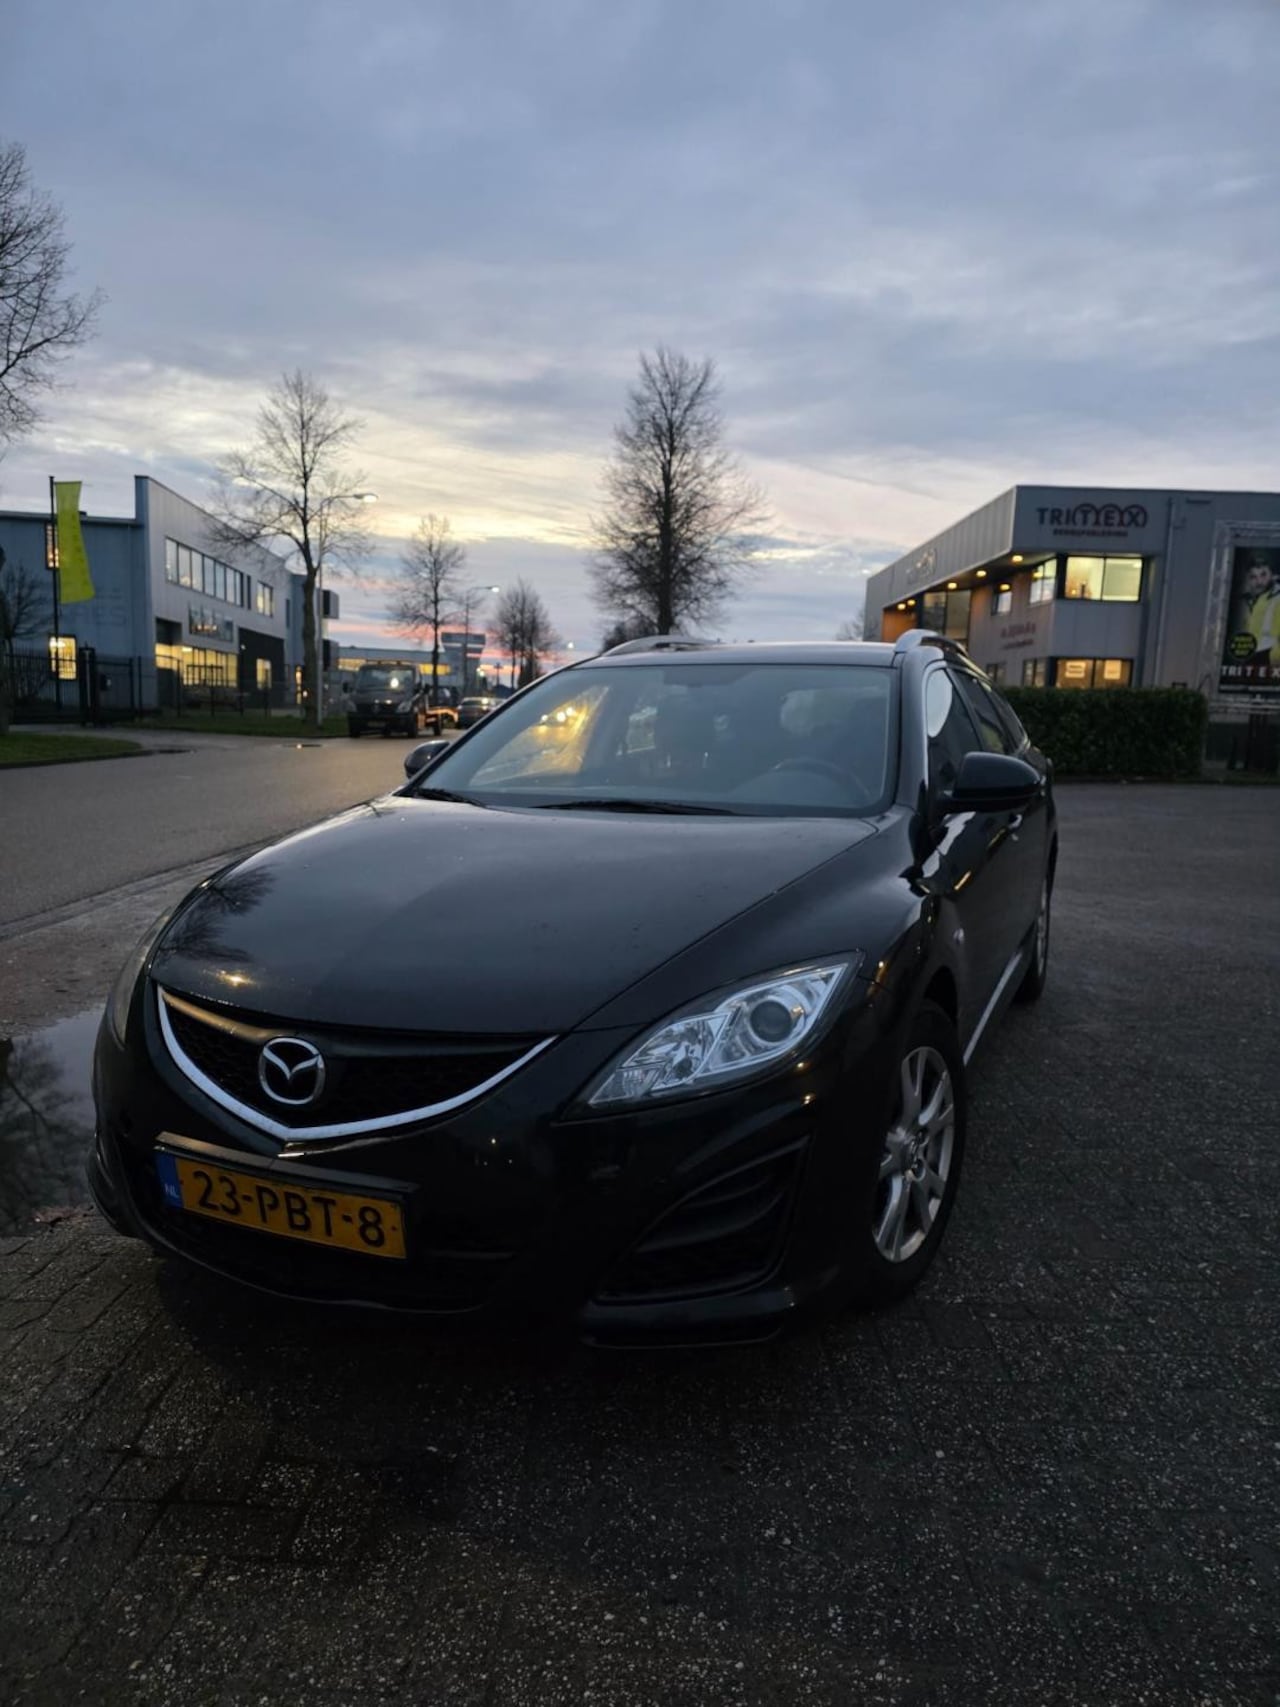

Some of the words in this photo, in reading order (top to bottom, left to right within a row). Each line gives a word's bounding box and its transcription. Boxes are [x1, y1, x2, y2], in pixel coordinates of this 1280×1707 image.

[1036, 503, 1149, 528] TRITEX
[164, 1183, 180, 1199] NL
[192, 1171, 386, 1248] 23-PBT-8
